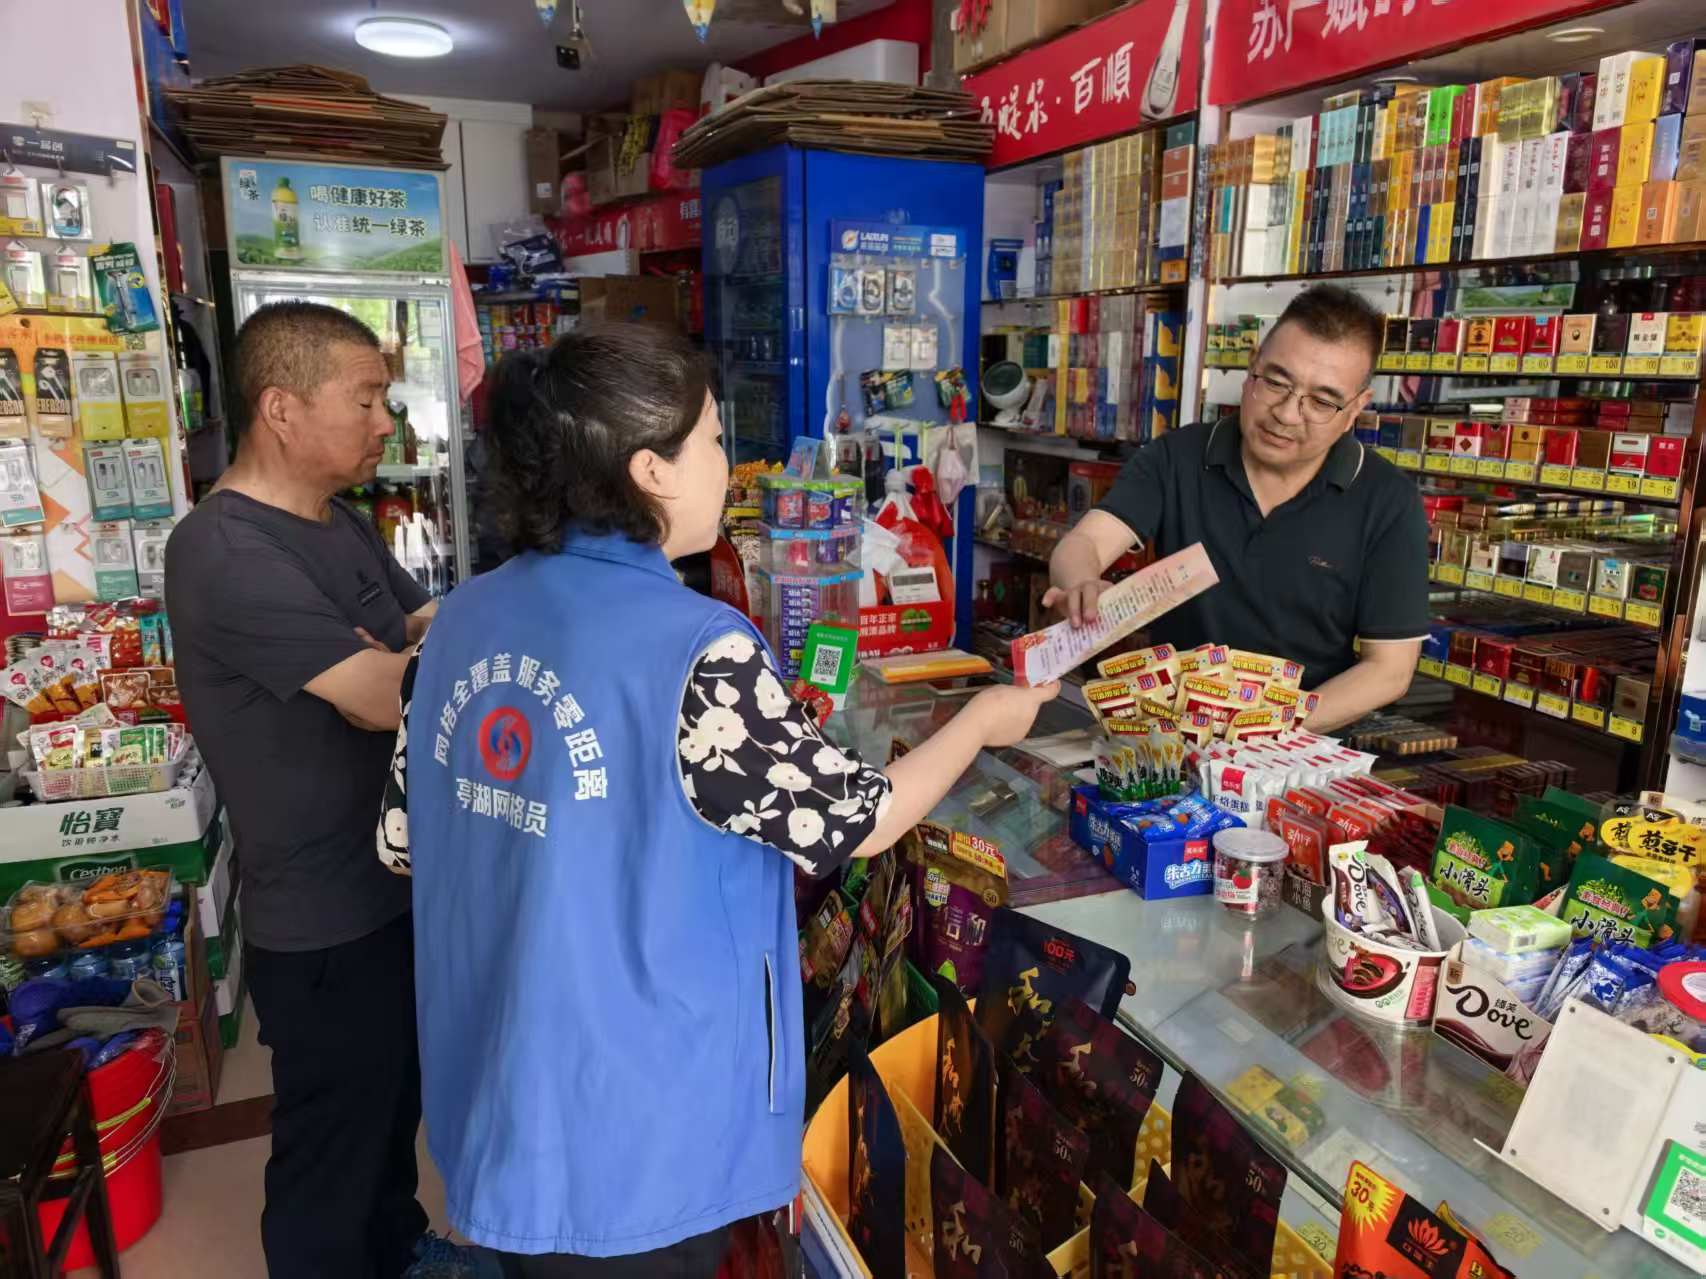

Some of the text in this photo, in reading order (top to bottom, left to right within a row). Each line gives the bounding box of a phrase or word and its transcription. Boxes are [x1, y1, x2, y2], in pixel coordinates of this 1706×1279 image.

[310, 185, 408, 209] 喝健康好茶
[313, 214, 426, 237] 认准统一绿茶
[434, 653, 608, 801] 网格全覆盖 服务零距离
[59, 807, 125, 836] 怡寶
[456, 778, 548, 838] 亭湖网格员
[62, 834, 121, 848] 饮用纯净水
[1640, 830, 1697, 863] 煎豆干
[1348, 854, 1367, 915] Dove
[1440, 861, 1490, 905] 小滑头
[1570, 910, 1637, 948] 小滑头
[1446, 984, 1535, 1041] Dove
